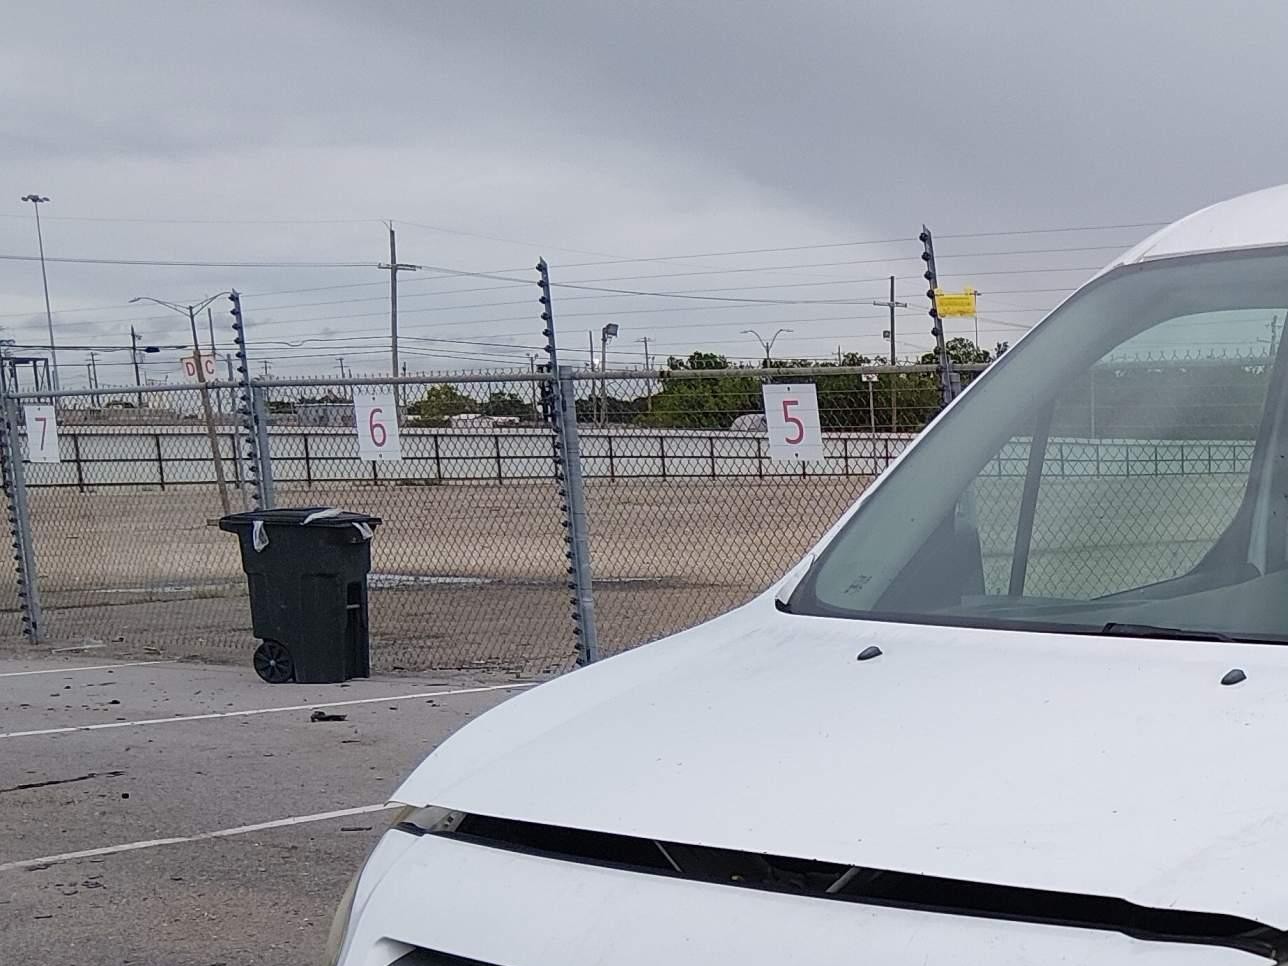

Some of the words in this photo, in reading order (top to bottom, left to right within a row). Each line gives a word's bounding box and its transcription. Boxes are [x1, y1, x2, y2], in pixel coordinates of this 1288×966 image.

[186, 361, 196, 377] D
[205, 359, 215, 375] C
[34, 417, 47, 452] 7
[369, 407, 387, 448] 6
[782, 400, 804, 445] 5
